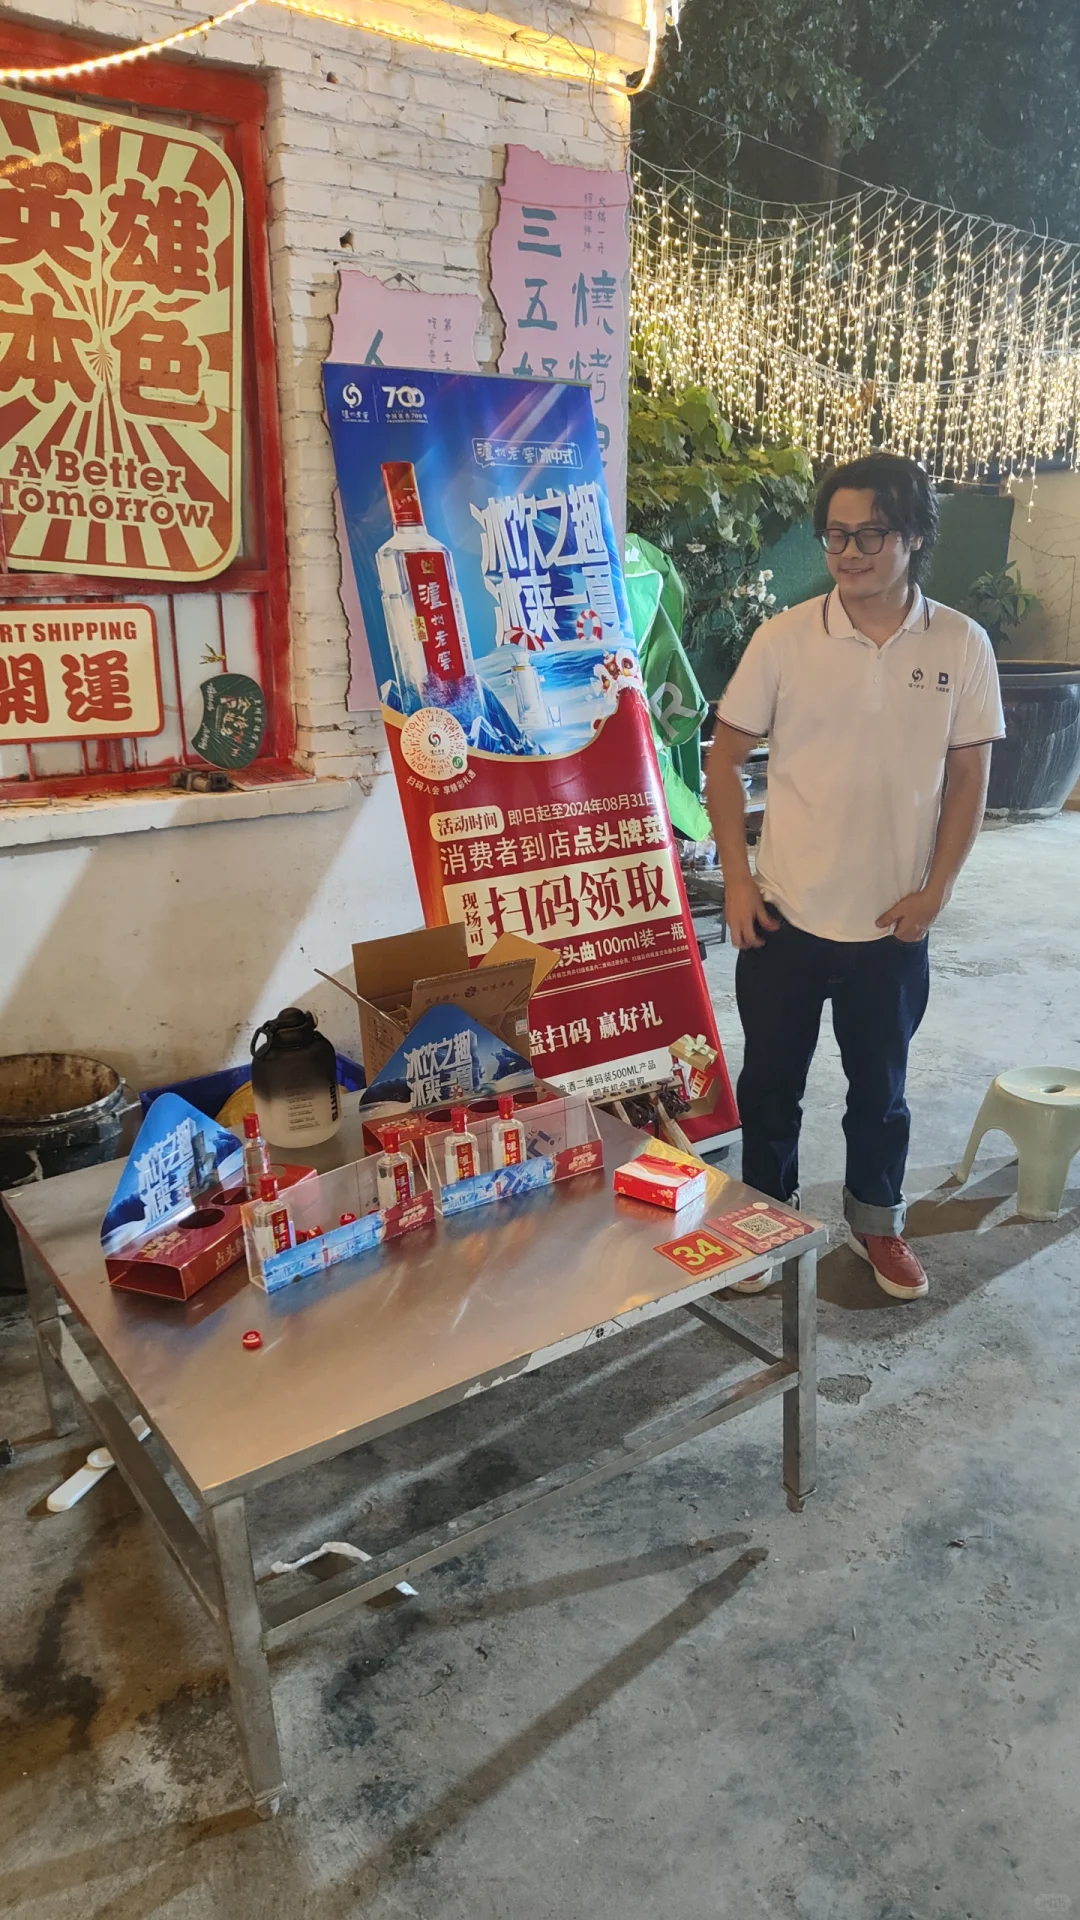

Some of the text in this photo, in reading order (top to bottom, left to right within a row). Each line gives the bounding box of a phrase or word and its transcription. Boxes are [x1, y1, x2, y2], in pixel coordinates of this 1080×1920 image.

[0, 154, 212, 295] 英雄
[0, 292, 214, 425] 本色
[9, 445, 181, 493] A Better
[0, 480, 210, 528] Tomorrow
[32, 621, 137, 642] SHIPPING
[406, 776, 440, 795] 扫码入会
[508, 791, 657, 827] 即日起至2024年08月31日
[437, 811, 498, 836] 活动时间
[440, 814, 669, 876] 消费者到店点头牌菜
[460, 892, 484, 946] 现场可
[485, 861, 671, 938] 扫码领取
[529, 1017, 592, 1057] 盖扫码
[596, 1002, 664, 1041] 赢好礼
[672, 1238, 724, 1267] 34
